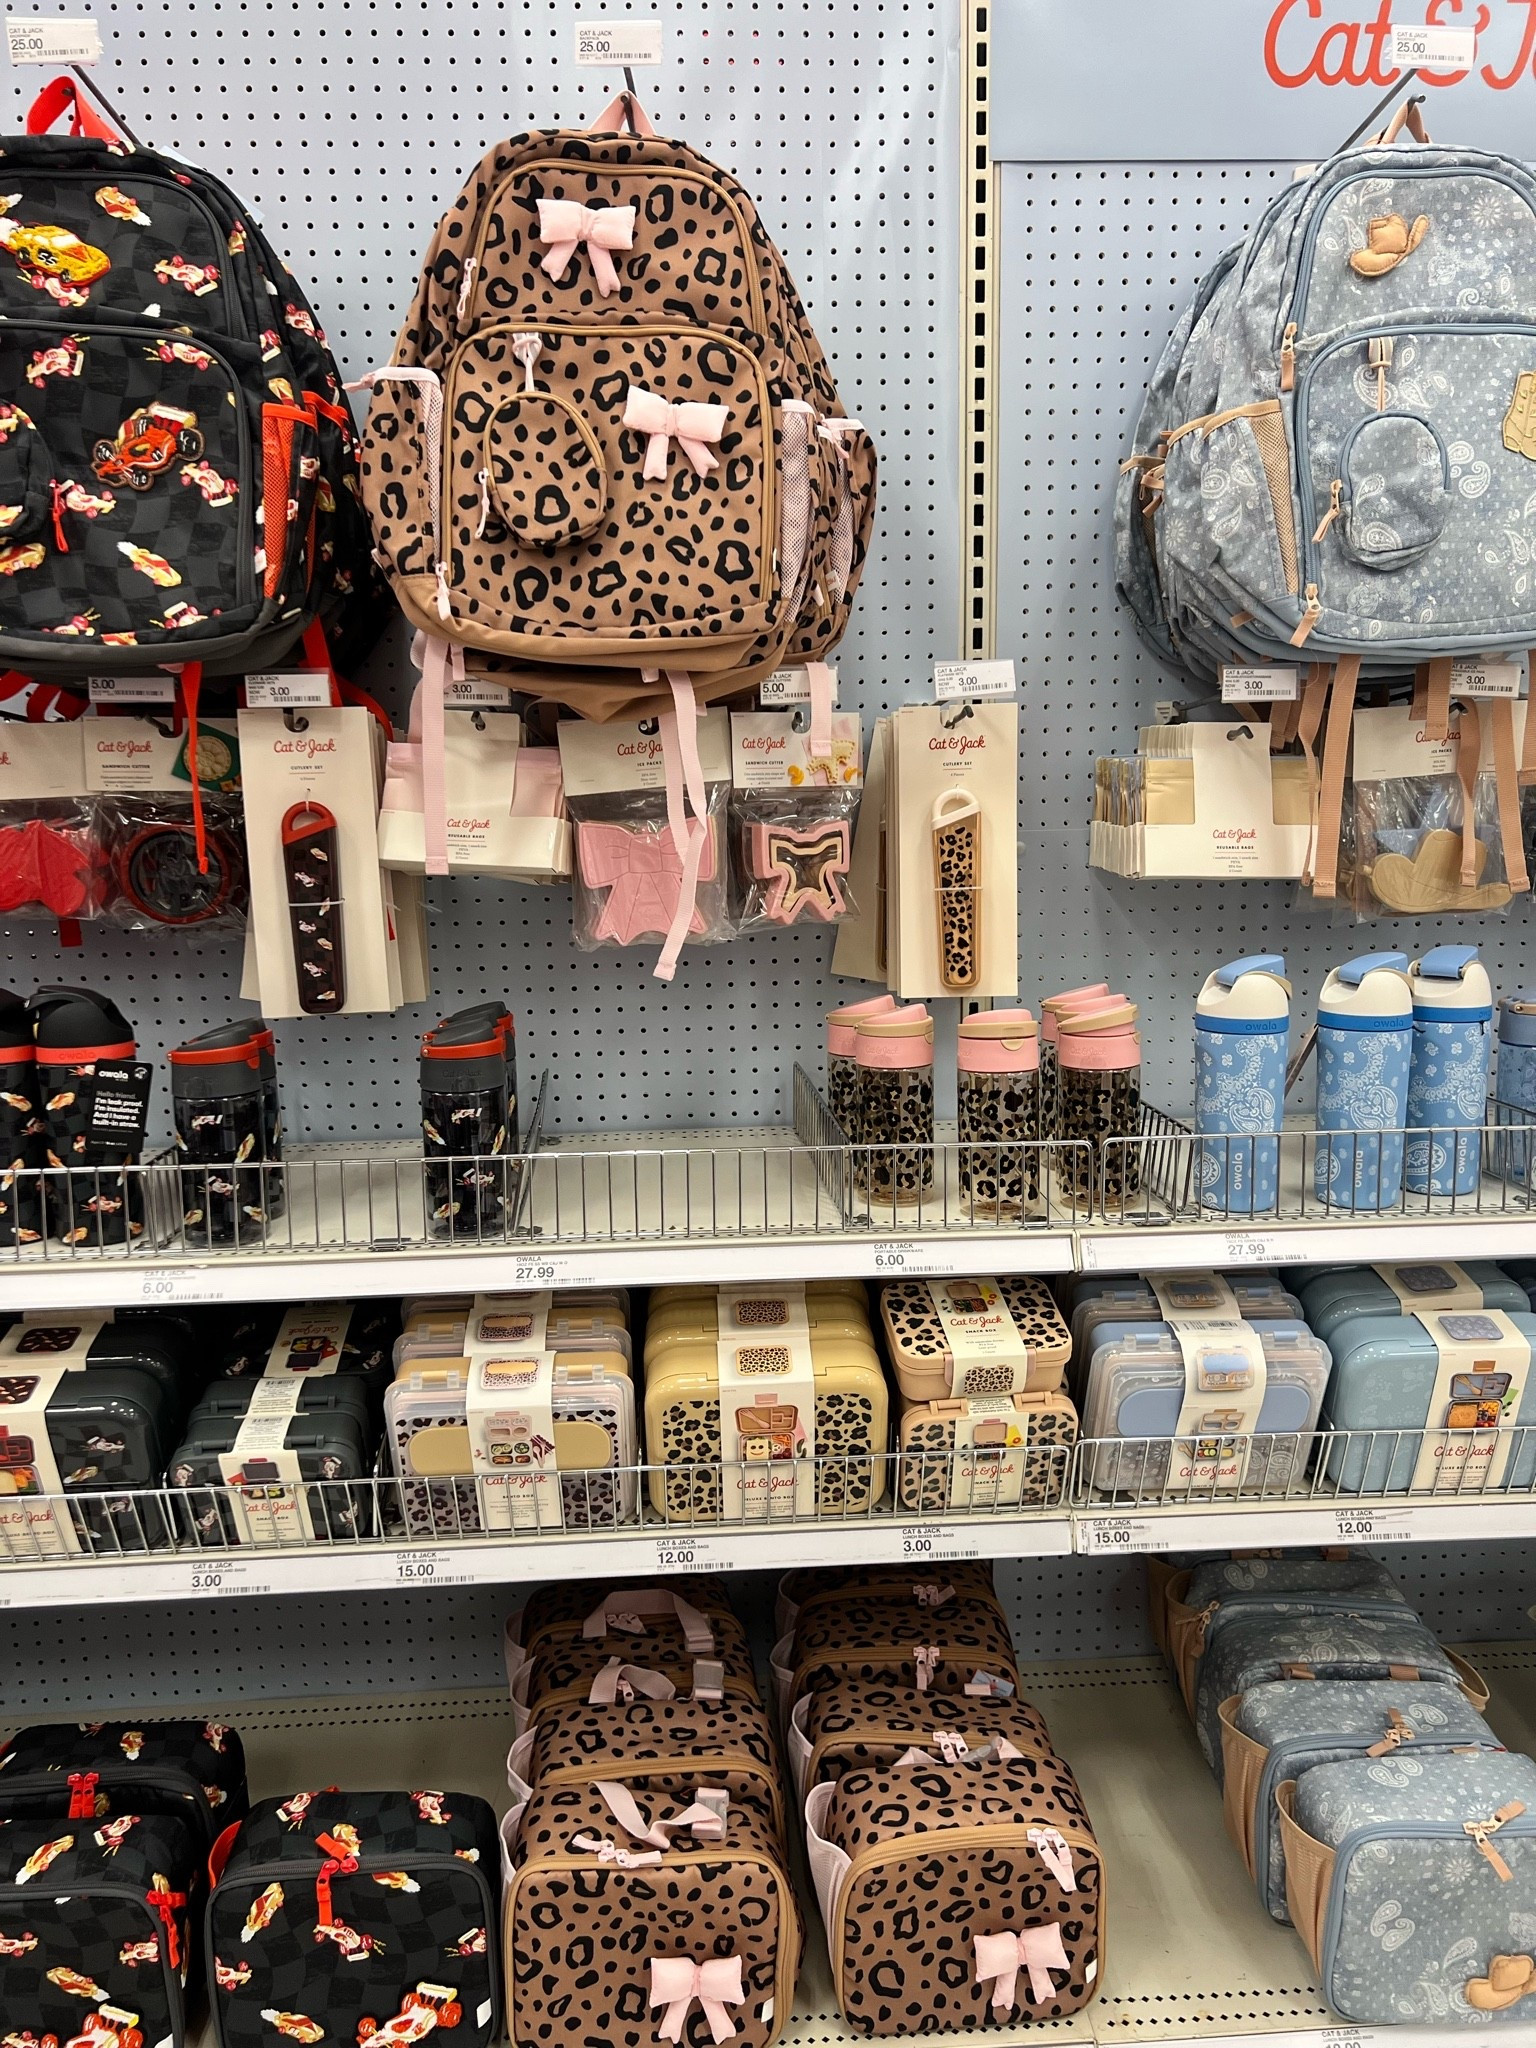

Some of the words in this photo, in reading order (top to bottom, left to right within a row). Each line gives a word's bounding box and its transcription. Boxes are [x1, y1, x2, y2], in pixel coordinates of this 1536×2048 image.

[11, 38, 43, 51] 25.00
[580, 41, 610, 52] 25.00
[1264, 0, 1400, 88] Cat
[1397, 42, 1426, 53] 25.00
[91, 679, 115, 689] 5.00
[958, 676, 978, 686] 3.00
[1244, 681, 1263, 689] 3.00
[1466, 676, 1485, 685] 3.00
[270, 687, 290, 696] 3.00
[452, 684, 472, 693] 3.00
[762, 683, 785, 693] 5.00
[97, 741, 115, 752] Cat
[116, 741, 128, 752] &
[127, 740, 153, 758] Jack
[274, 740, 294, 753] Cat
[295, 740, 307, 752] &
[307, 738, 337, 759] Jack
[617, 743, 636, 756] Cat
[637, 742, 647, 754] &
[648, 739, 663, 759] Ja
[742, 737, 756, 749] Cat
[757, 737, 766, 749] &
[765, 736, 786, 754] Jack
[928, 738, 948, 750] Cat
[948, 737, 960, 749] &
[959, 735, 986, 755] Jack
[447, 819, 461, 827] Cat
[461, 819, 471, 828] &
[469, 819, 490, 832] Jack
[1212, 829, 1227, 839] Cat
[1227, 829, 1236, 839] &
[1236, 828, 1257, 843] Jack
[1245, 1020, 1277, 1030] owala
[1374, 1018, 1404, 1028] owala
[59, 1051, 96, 1060] owala
[98, 1070, 129, 1079] owala
[96, 1090, 114, 1098] Hello
[115, 1091, 136, 1099] friend.
[106, 1105, 140, 1114] insulated.
[92, 1119, 118, 1127] built-in
[1458, 1137, 1468, 1174] owala
[1232, 1152, 1243, 1190] owala
[1354, 1150, 1364, 1188] owala
[1227, 1243, 1265, 1256] 27.99
[875, 1254, 905, 1266] 6.00
[516, 1266, 555, 1279] 27.99
[142, 1281, 174, 1294] 6.00
[950, 1318, 968, 1326] Cat
[968, 1317, 978, 1325] &
[978, 1315, 1005, 1328] Jack
[980, 1467, 990, 1475] &
[1200, 1466, 1211, 1476] &
[1209, 1465, 1237, 1480] Jack
[736, 1479, 757, 1490] Cat
[758, 1478, 768, 1488] &
[0, 1514, 11, 1524] at
[11, 1513, 23, 1523] &
[1337, 1521, 1372, 1534] 12.00
[1094, 1531, 1130, 1543] 15.00
[903, 1540, 931, 1552] 3.00
[657, 1551, 694, 1564] 12.00
[397, 1564, 434, 1577] 15.00
[192, 1574, 222, 1587] 3.00
